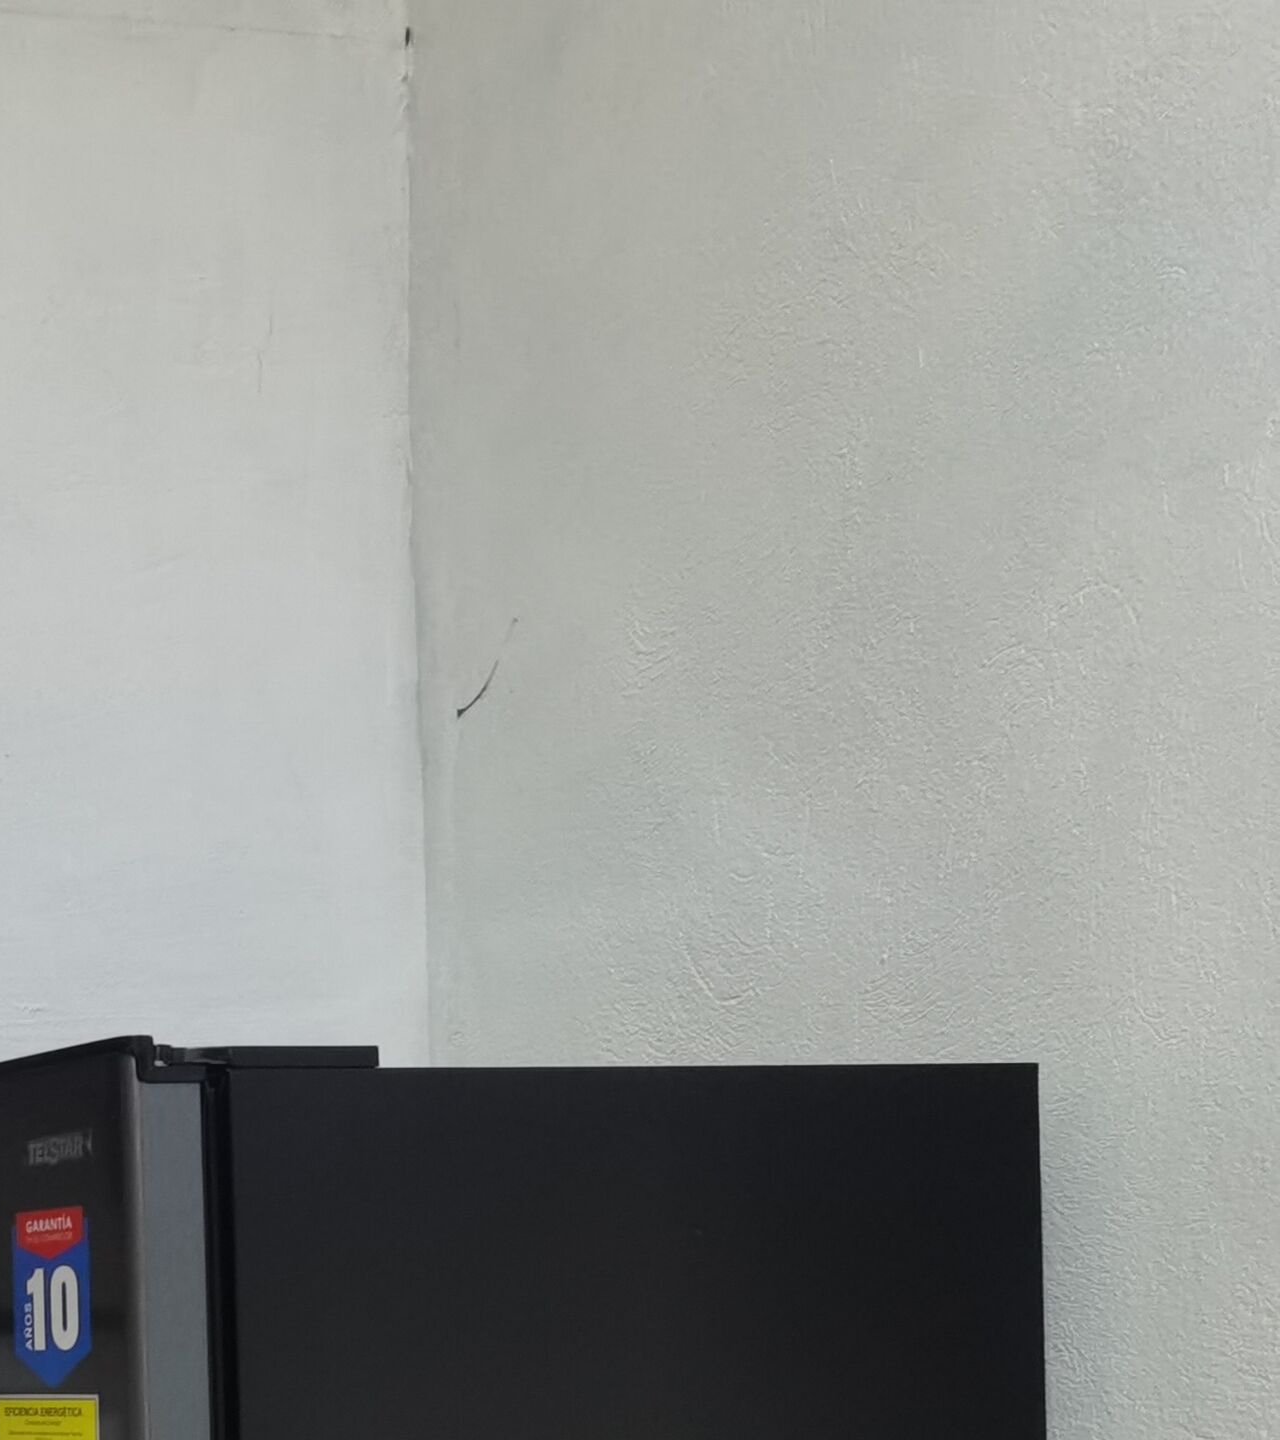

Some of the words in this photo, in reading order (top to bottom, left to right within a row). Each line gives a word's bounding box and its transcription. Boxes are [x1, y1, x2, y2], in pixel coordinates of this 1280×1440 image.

[26, 1134, 83, 1166] TELSTAR
[25, 1213, 72, 1234] GARANTÍA
[24, 1302, 33, 1351] AÑOS
[26, 1264, 79, 1351] 10
